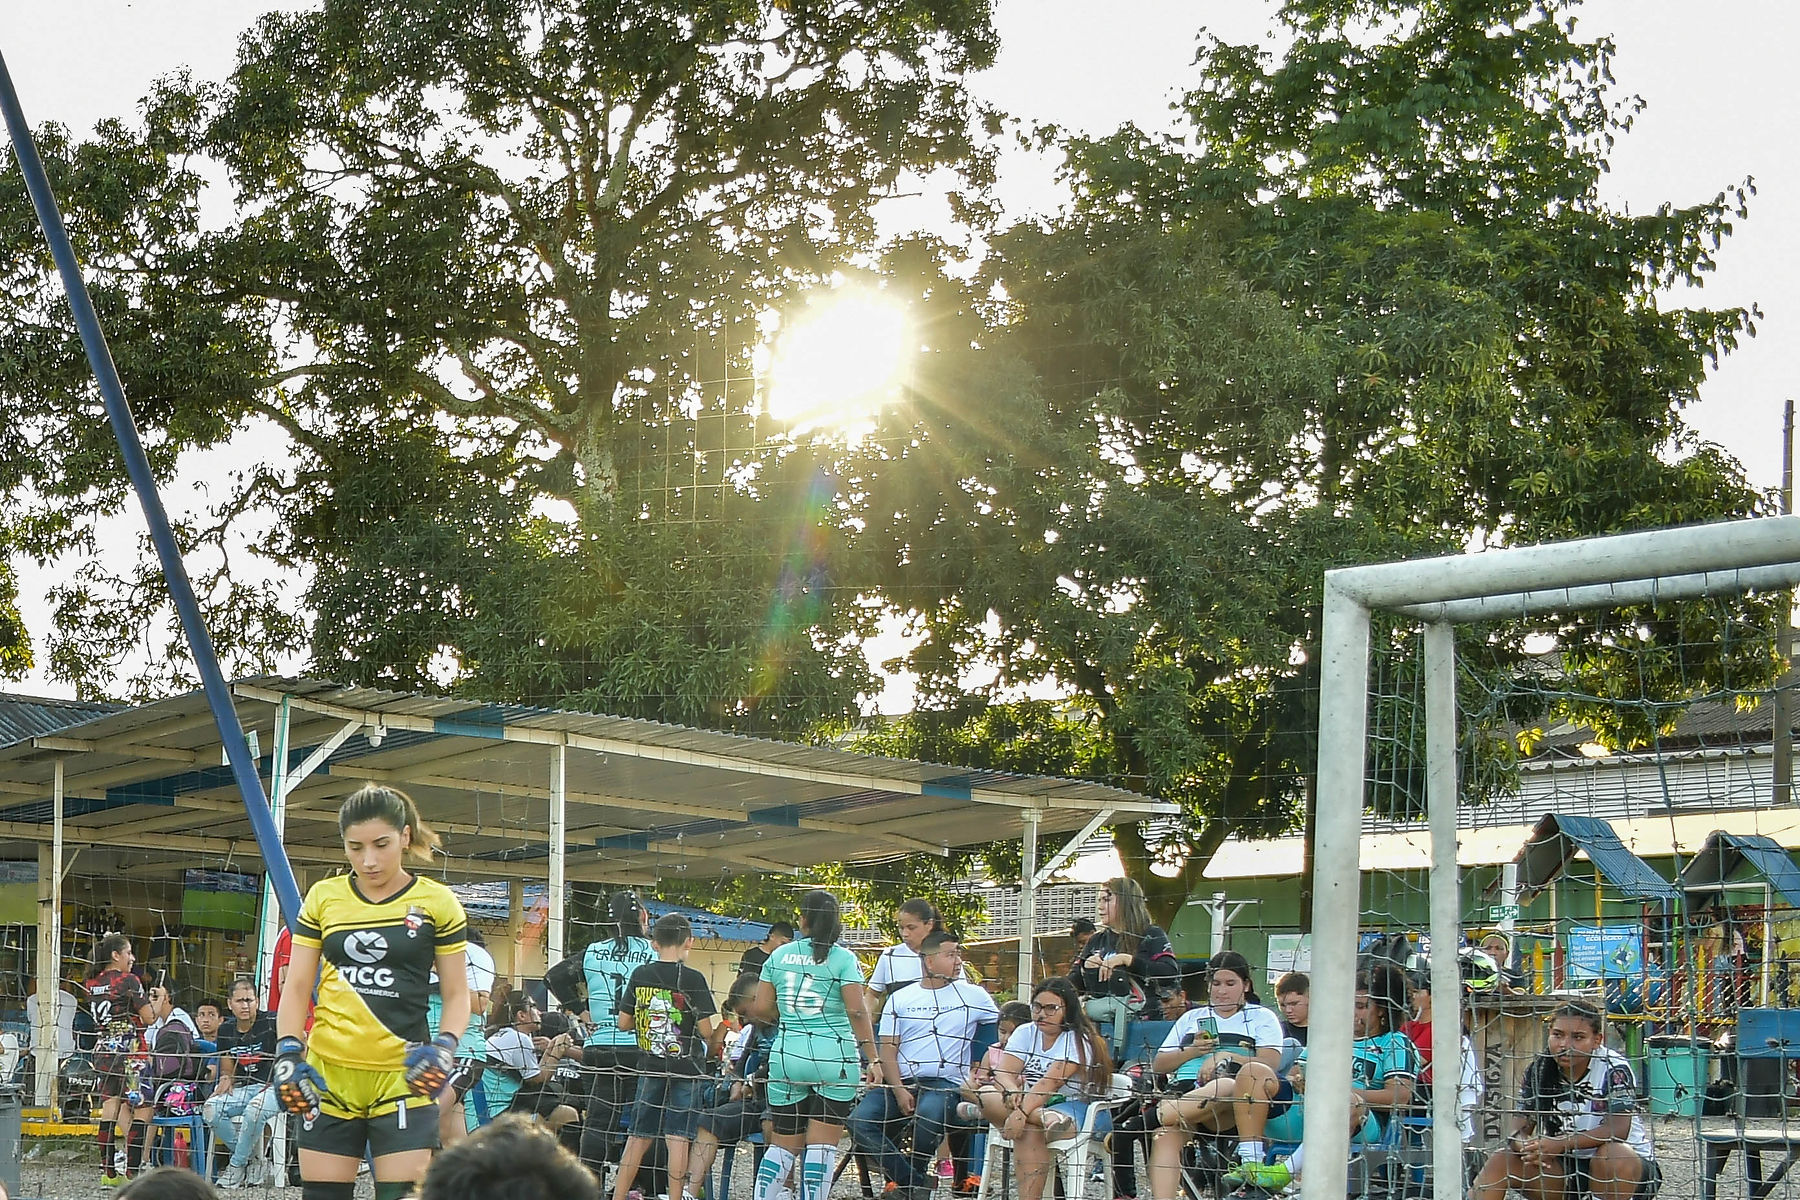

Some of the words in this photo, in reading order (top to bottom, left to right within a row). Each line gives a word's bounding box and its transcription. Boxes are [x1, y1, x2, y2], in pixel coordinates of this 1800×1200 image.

[338, 965, 395, 988] MCG
[784, 971, 826, 1016] 16
[396, 1099, 407, 1129] 1
